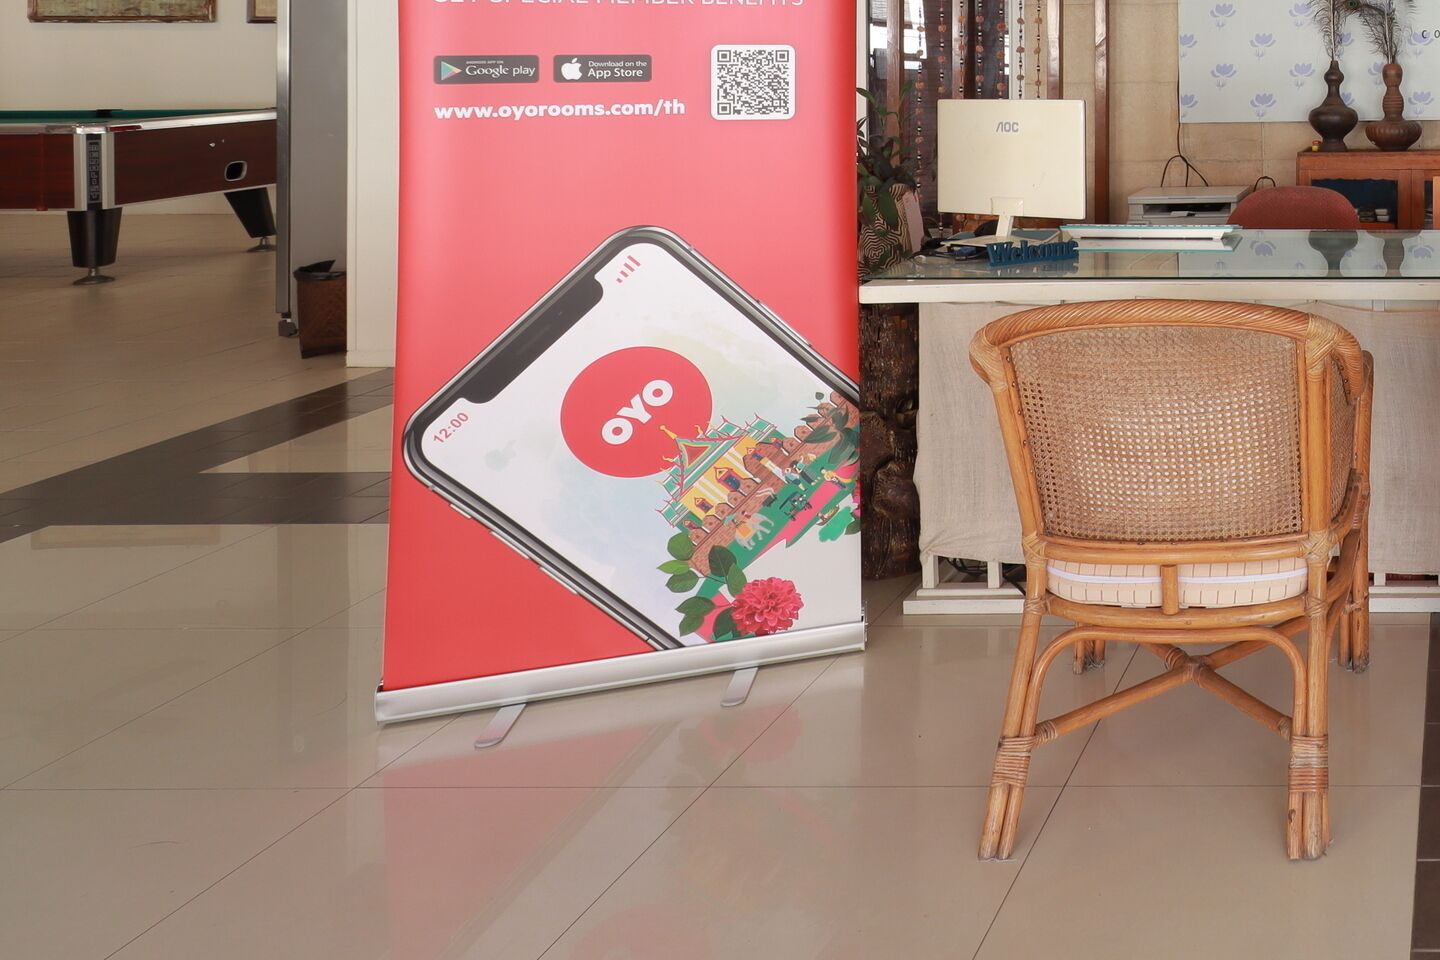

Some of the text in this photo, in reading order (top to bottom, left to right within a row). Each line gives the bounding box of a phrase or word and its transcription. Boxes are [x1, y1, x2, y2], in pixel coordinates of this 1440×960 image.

[465, 65, 535, 78] Google play
[588, 67, 643, 79] App Store
[434, 99, 686, 121] www.oyorooms.com/th
[996, 121, 1019, 133] AOC
[602, 380, 674, 444] OYO
[433, 411, 469, 444] 12:00
